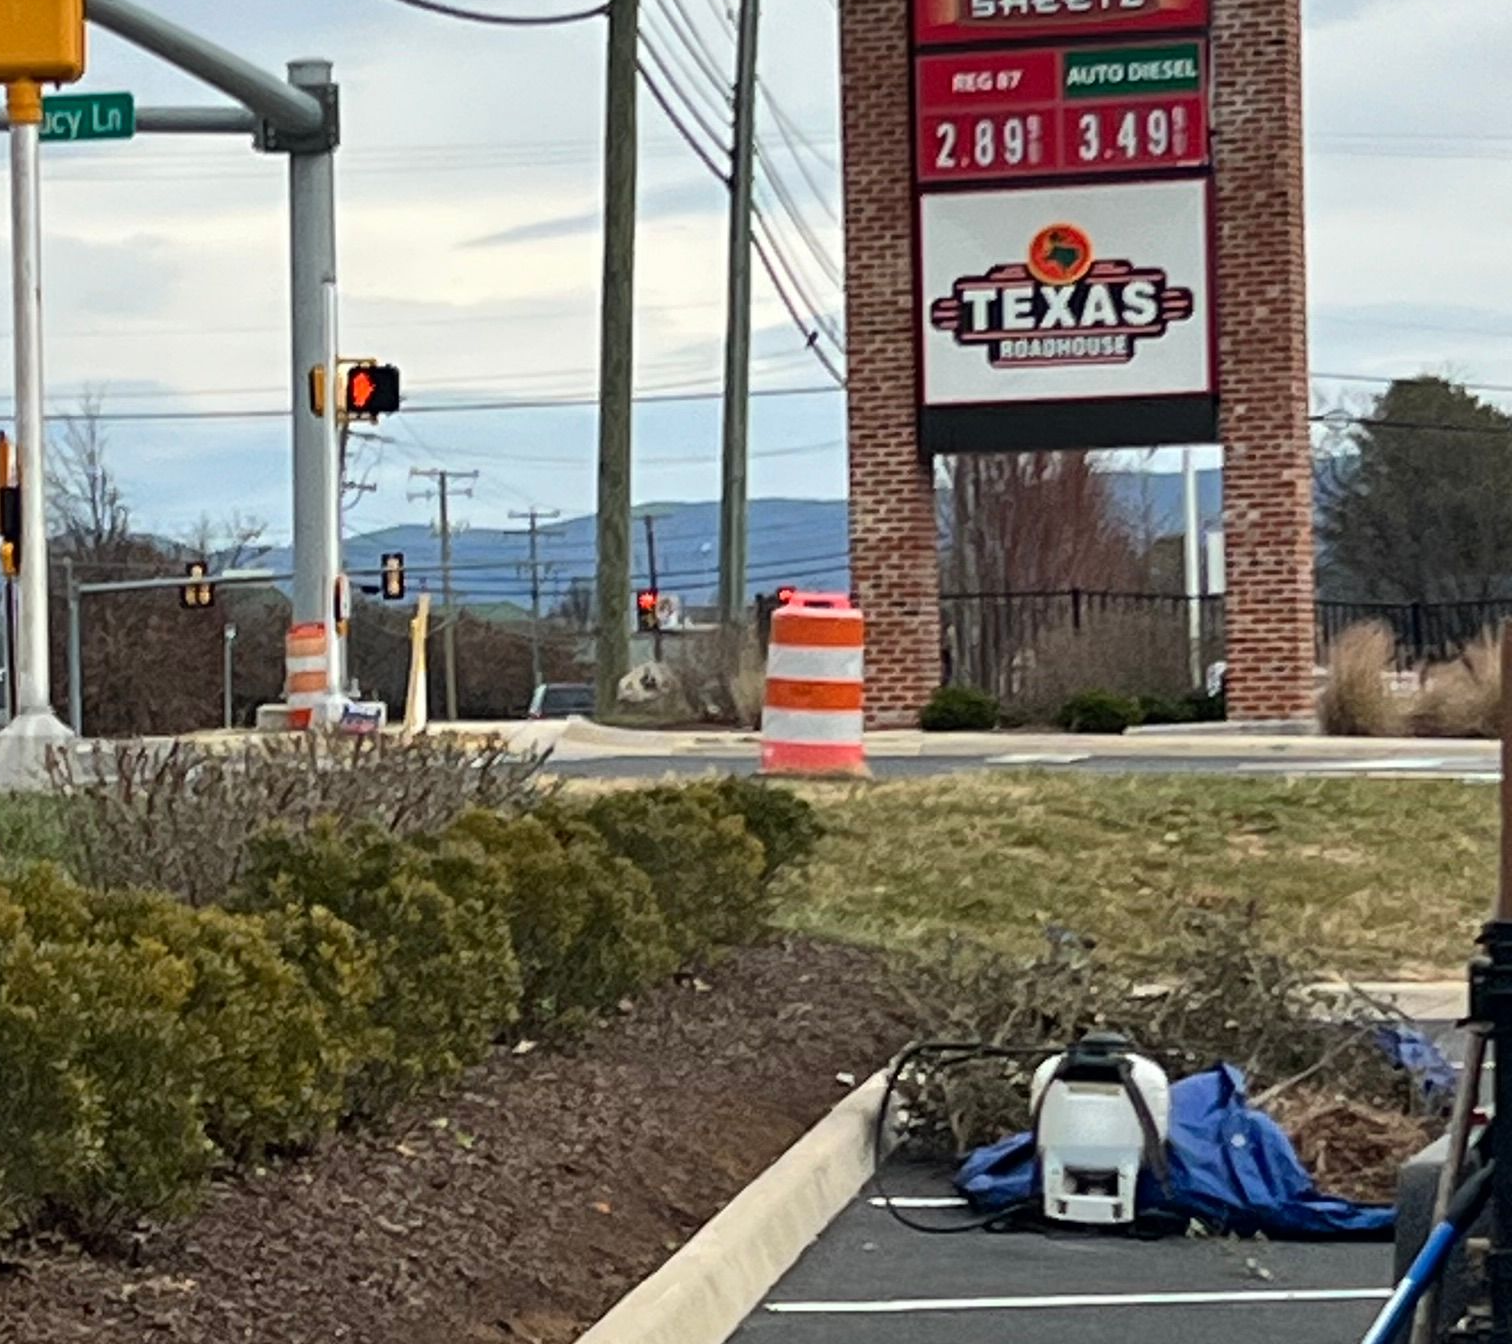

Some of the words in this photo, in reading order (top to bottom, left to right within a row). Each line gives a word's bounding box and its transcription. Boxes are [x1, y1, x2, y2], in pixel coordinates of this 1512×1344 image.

[952, 71, 993, 92] REG
[1066, 62, 1125, 86] AUTO
[1127, 58, 1197, 81] DIESEL
[92, 102, 121, 131] Ln
[961, 280, 1158, 331] TEXAS
[999, 334, 1127, 358] ROADHOUSE
